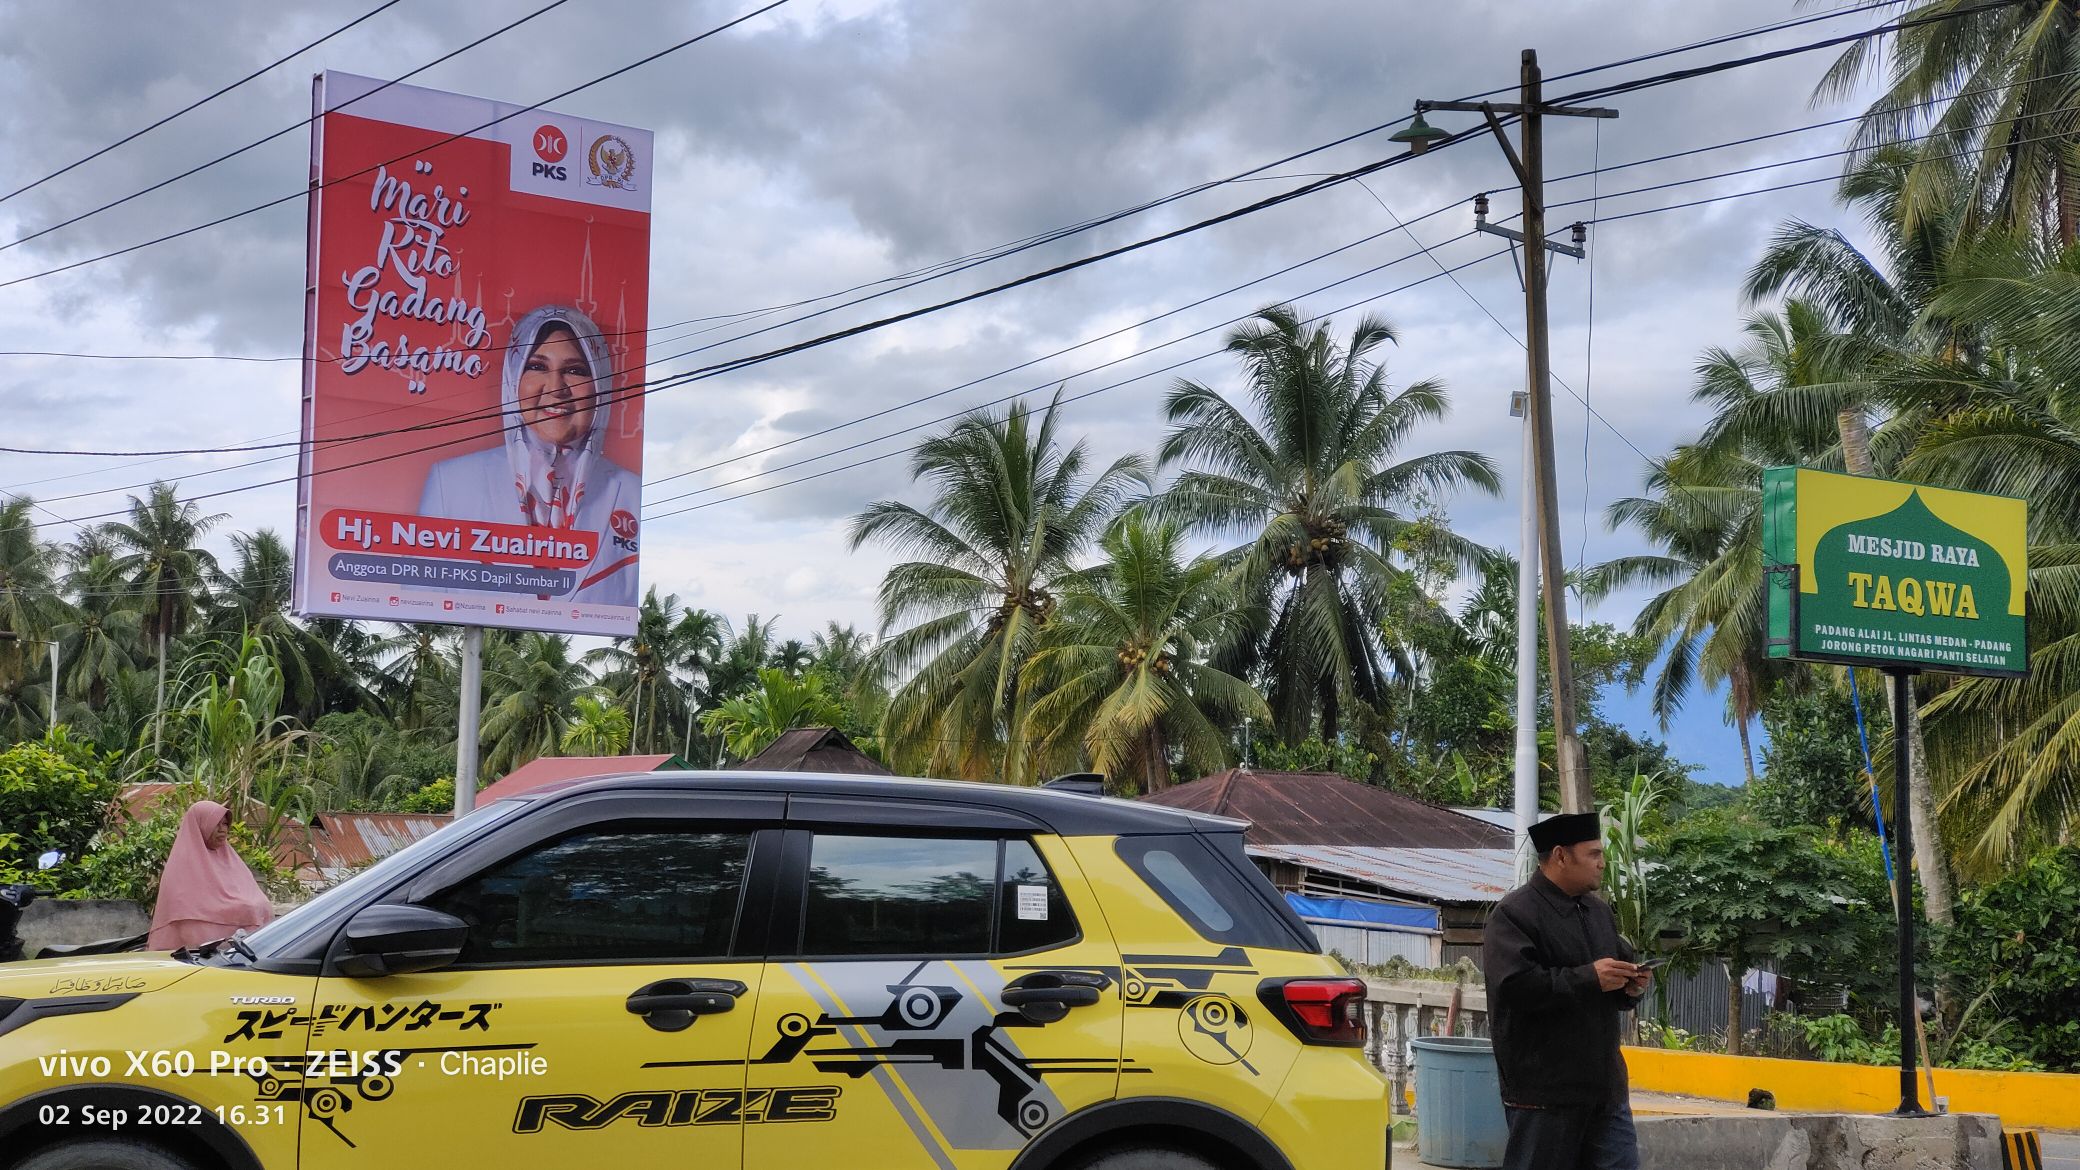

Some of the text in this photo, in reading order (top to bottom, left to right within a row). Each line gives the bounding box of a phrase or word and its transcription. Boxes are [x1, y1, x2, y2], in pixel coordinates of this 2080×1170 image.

[532, 162, 568, 182] PKS
[370, 164, 471, 228] Mari
[342, 266, 492, 349] Gadang
[341, 322, 490, 377] Basamo
[337, 516, 589, 561] Hj. Nevi Zuairina
[613, 537, 638, 552] PKS
[1848, 534, 1980, 567] MESJID RAYA
[335, 559, 387, 578] Anggota
[392, 564, 420, 579] DPR
[425, 566, 437, 579] RI
[441, 568, 477, 583] F-PKS
[482, 570, 512, 588] Dapil
[515, 573, 559, 589] Sumbar
[1848, 572, 1980, 619] TAQWA
[1815, 624, 1855, 638] PADANG
[1858, 629, 1880, 639] ALAI
[1882, 631, 1896, 641] JL.
[1898, 632, 1932, 644] LINTAS
[1935, 636, 1967, 648] MEDAN
[1974, 639, 2012, 652] PADANG
[1821, 640, 2006, 665] JORONG PETOK NAGARI PANTI SELATAN
[230, 996, 296, 1004] TURBO
[224, 1000, 503, 1043] スピードハンターズ
[512, 1086, 842, 1134] RAIZE
